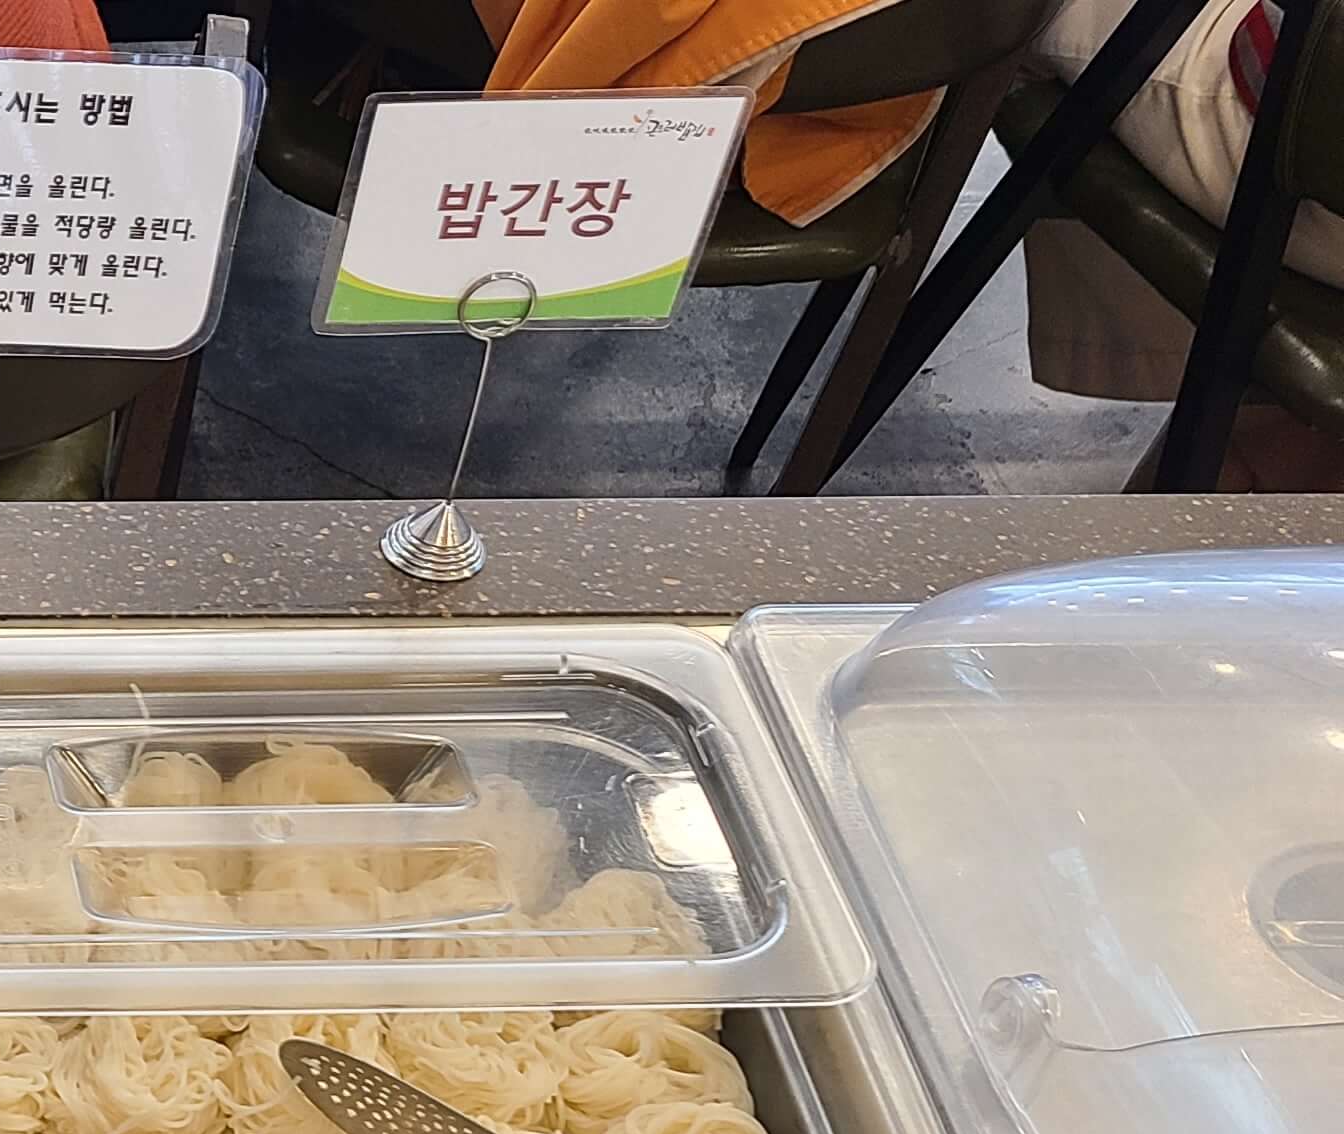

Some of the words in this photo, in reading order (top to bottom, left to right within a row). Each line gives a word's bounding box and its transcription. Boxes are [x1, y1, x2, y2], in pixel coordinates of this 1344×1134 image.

[79, 93, 134, 127] 방법
[48, 175, 115, 200] 올린다.
[437, 178, 632, 240] 밥간장
[54, 214, 117, 240] 적당량
[129, 216, 196, 241] 올린다.
[48, 253, 89, 277] 맞게
[101, 254, 168, 278] 올린다.
[48, 291, 114, 315] 먹는다.
